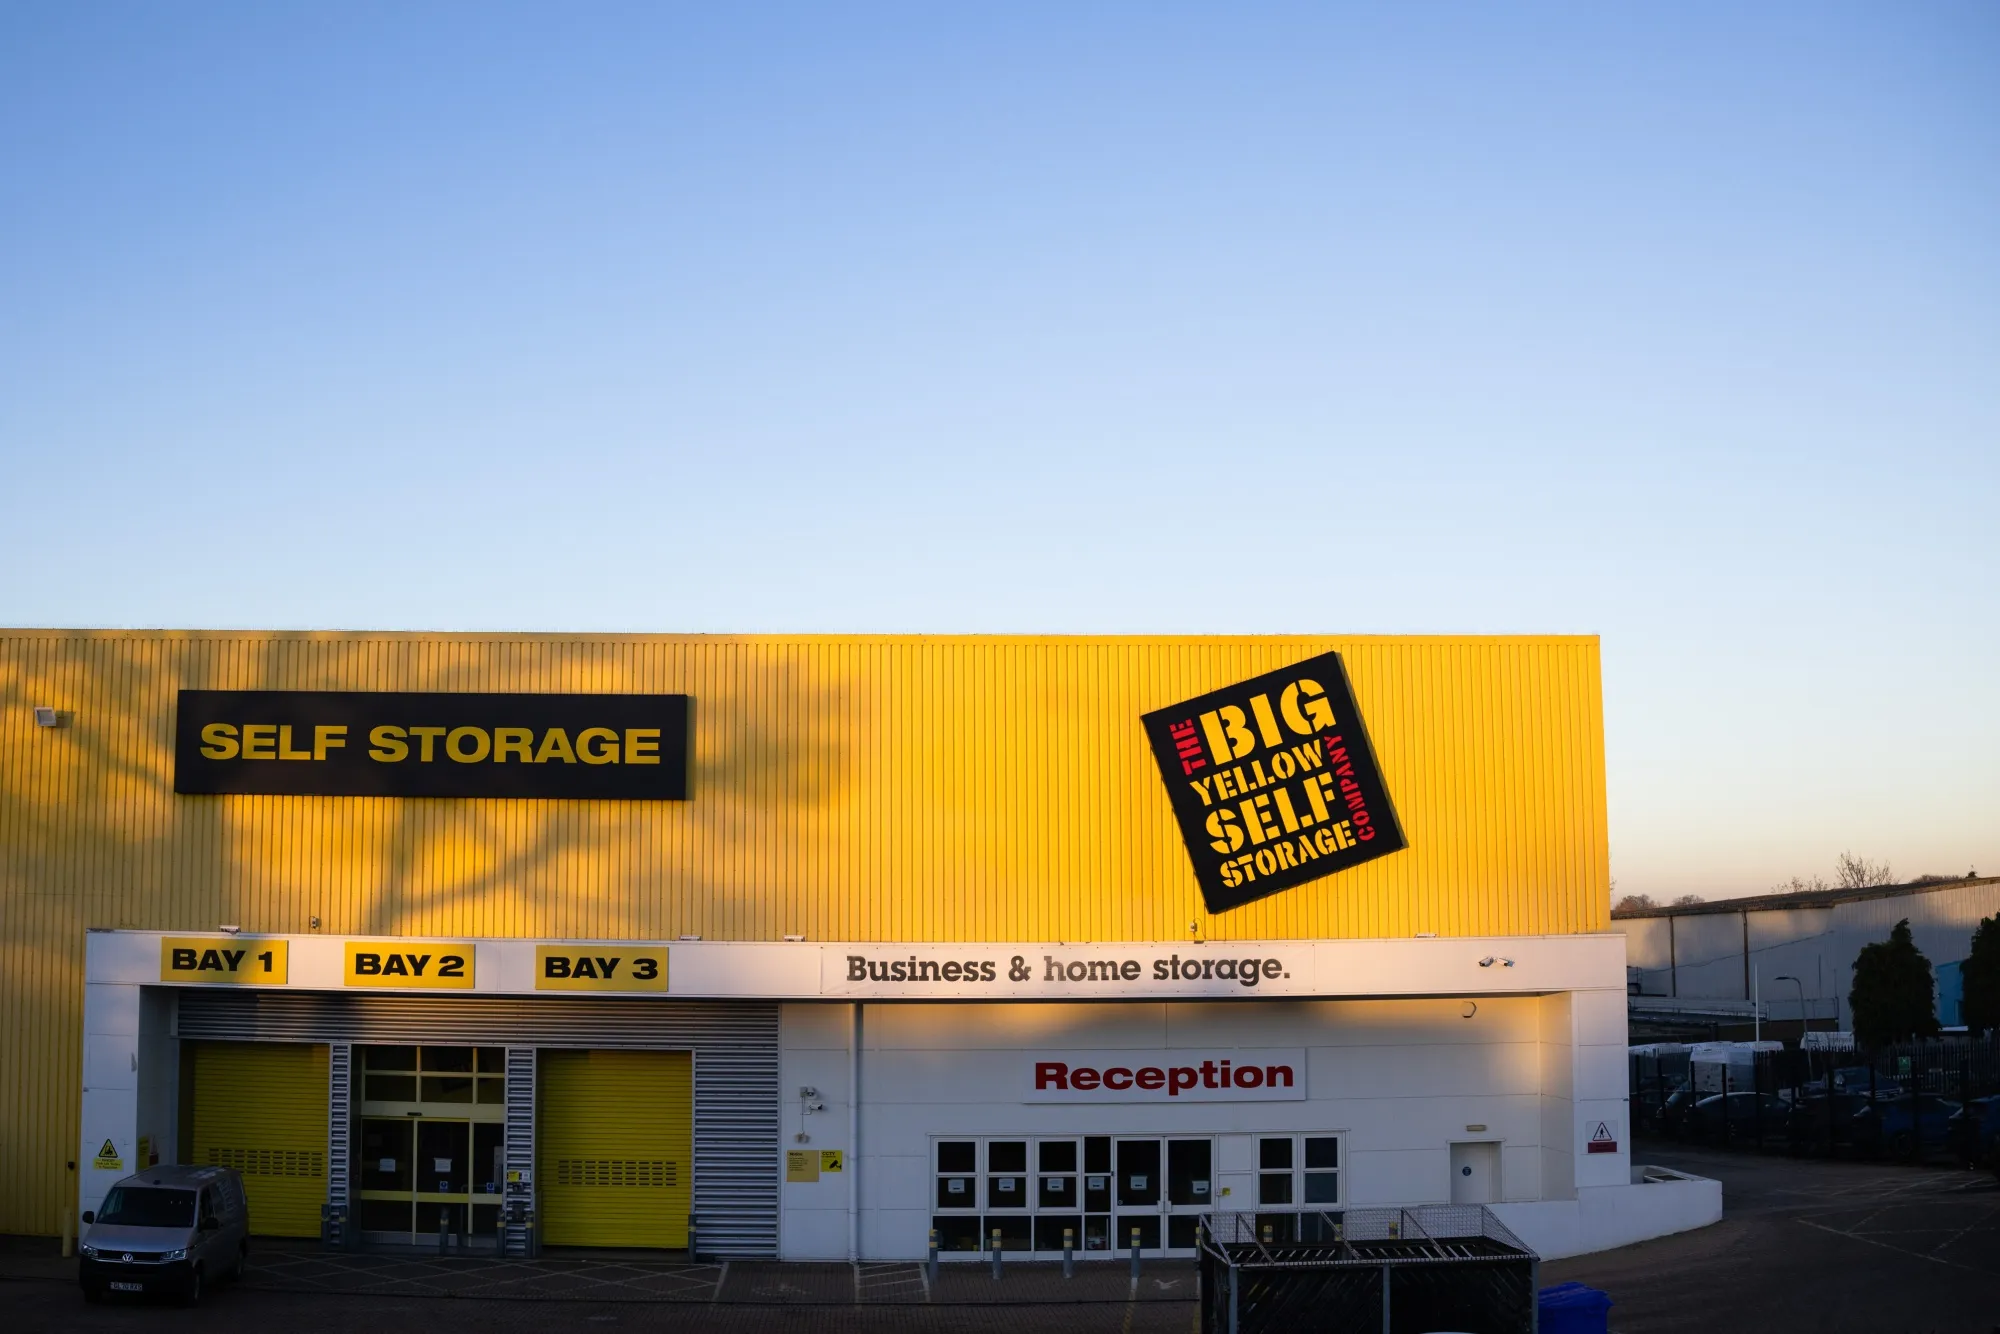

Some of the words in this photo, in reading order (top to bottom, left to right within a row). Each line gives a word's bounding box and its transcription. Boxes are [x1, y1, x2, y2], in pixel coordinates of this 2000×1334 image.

[200, 723, 347, 761] SELF
[368, 725, 661, 765] STORAGE
[1170, 718, 1206, 776] THE
[1200, 678, 1337, 766] BIG
[1189, 739, 1324, 807] YELLOW
[1324, 735, 1376, 842] COMPANY
[1204, 772, 1336, 854] SELF
[1219, 819, 1357, 888] STORAGE
[172, 948, 247, 973] BAY
[258, 951, 273, 973] 1
[355, 953, 431, 977] BAY
[437, 956, 465, 978] 2
[545, 956, 622, 980] BAY
[631, 957, 659, 981] 3
[846, 955, 996, 982] Business
[1008, 955, 1031, 982] &
[1044, 954, 1142, 981] home
[1153, 954, 1291, 988] storage.
[1035, 1060, 1294, 1096] Reception
